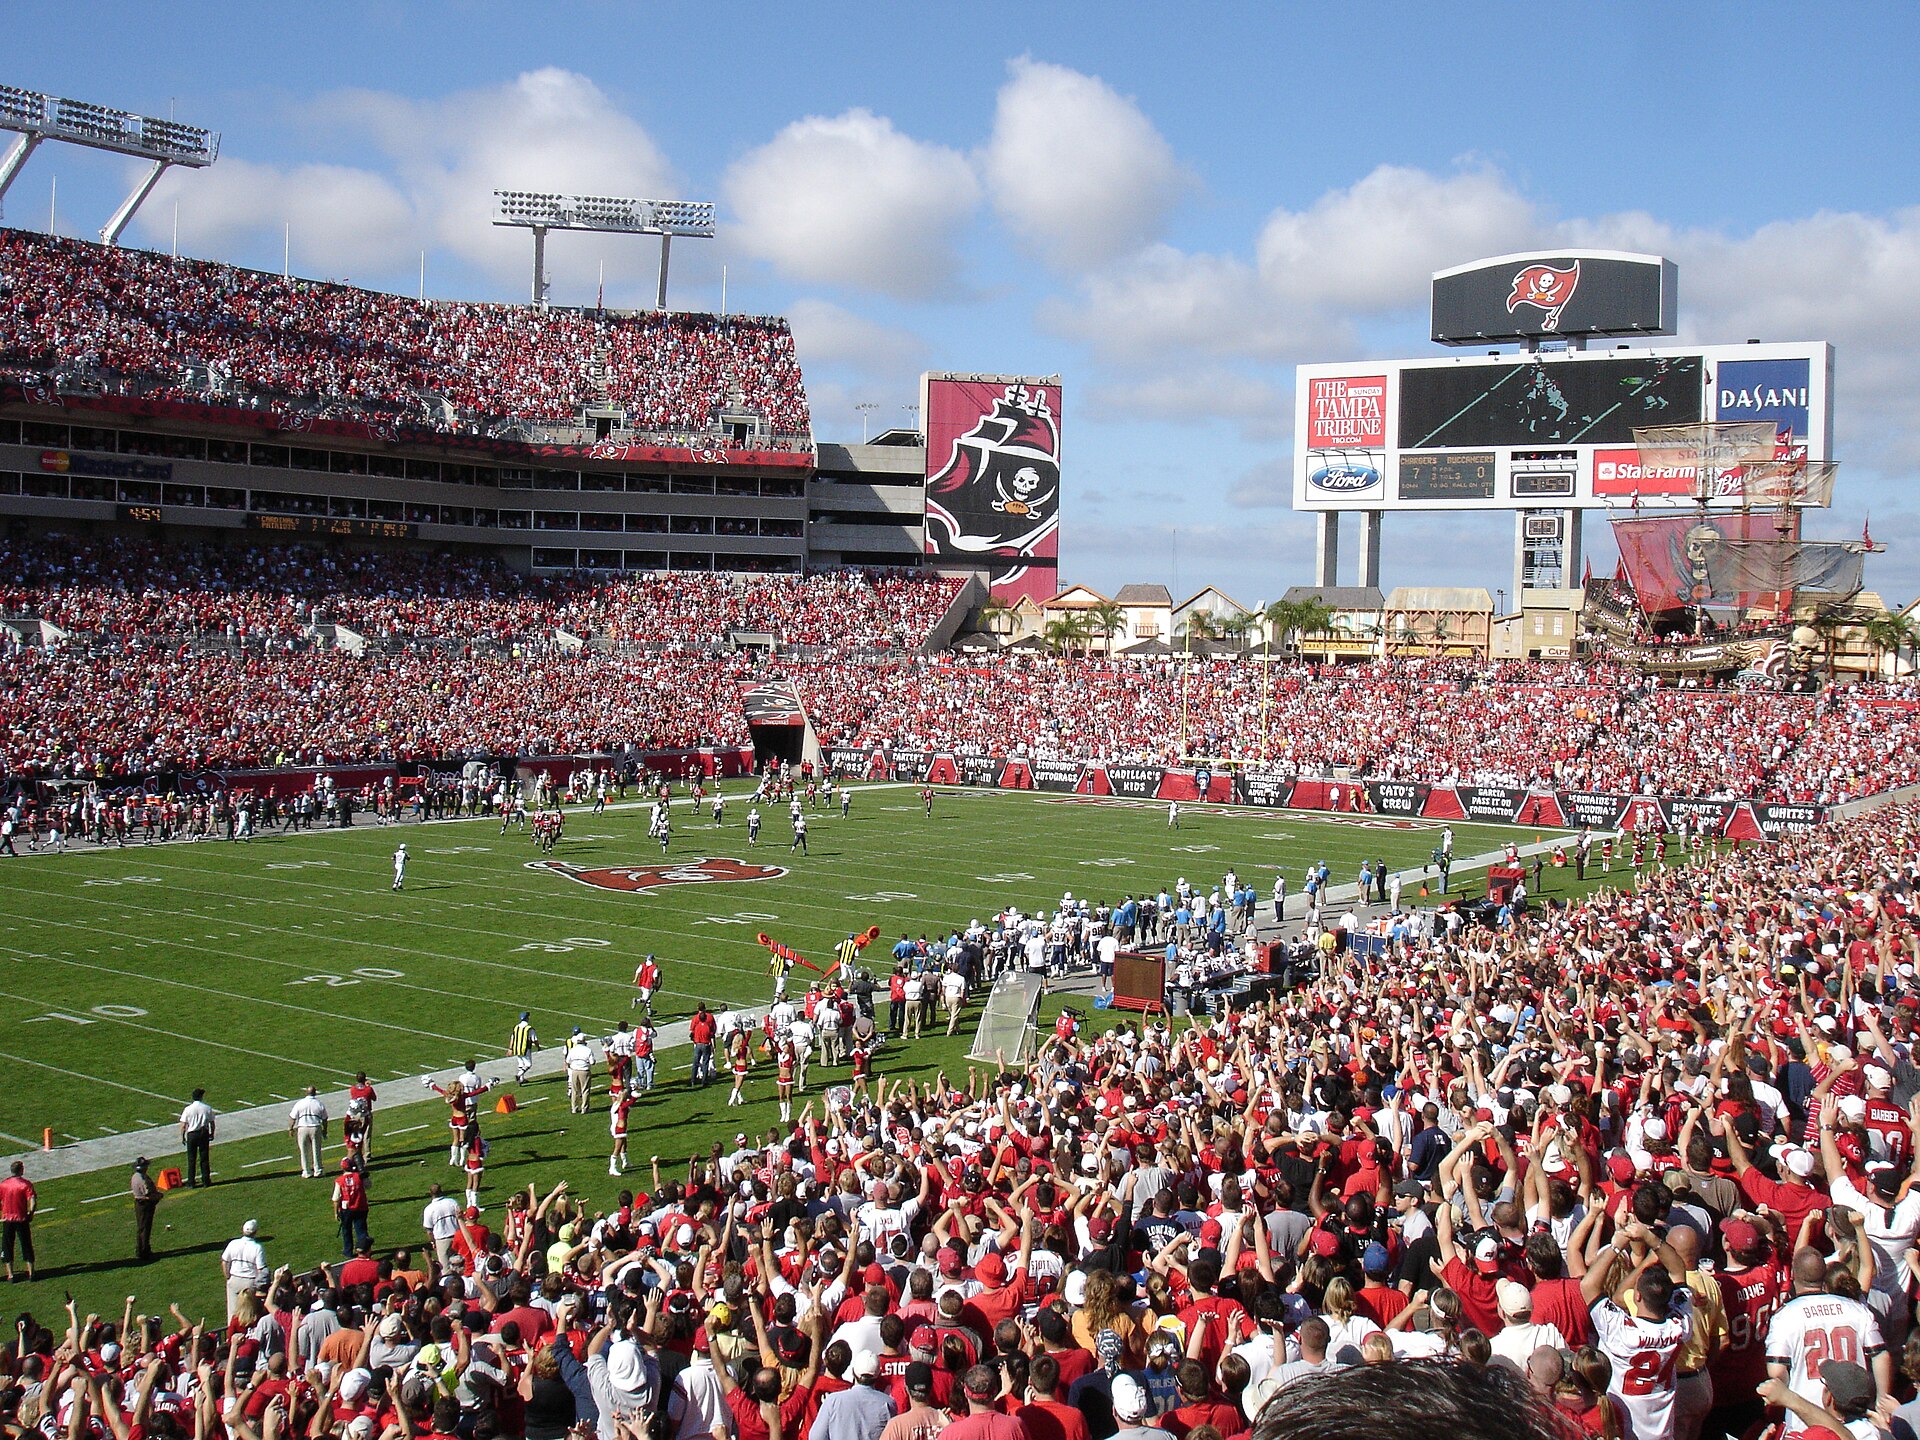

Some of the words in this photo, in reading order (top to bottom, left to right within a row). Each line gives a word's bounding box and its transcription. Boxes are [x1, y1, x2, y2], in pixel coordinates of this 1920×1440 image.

[1315, 381, 1347, 398] THE
[1353, 388, 1381, 396] SUNDAY
[1721, 383, 1806, 412] DASANI
[1315, 397, 1381, 419] TAMPA
[1314, 419, 1381, 437] TRIBUNE
[1400, 456, 1437, 465] CHARGERS
[1447, 455, 1494, 464] BUCCANEERS
[1322, 468, 1367, 488] Ford
[1477, 466, 1485, 478] 0
[129, 507, 161, 521] 4:54
[261, 516, 300, 525] CARDINALS
[1035, 771, 1079, 783] ENTOURAGE
[1109, 769, 1161, 782] CADILLAC'S
[1123, 781, 1146, 792] KIDS
[1379, 784, 1415, 797] CATO'S
[1478, 788, 1506, 798] GARCIA
[1253, 797, 1275, 806] BOAD
[1382, 798, 1412, 811] CREW
[1471, 797, 1490, 807] PASS
[1491, 798, 1501, 808] IT
[1501, 799, 1512, 809] ON
[1469, 806, 1514, 818] FOUNDATION
[1672, 803, 1722, 815] BRYANT'S
[1768, 807, 1814, 821] WHITE'S
[705, 912, 779, 924] 40
[1054, 932, 1066, 942] 97
[522, 937, 612, 953] 30
[302, 967, 406, 987] 20
[46, 1004, 149, 1025] 10
[1870, 1109, 1899, 1123] BARBER
[1184, 1220, 1203, 1230] WILLI
[1030, 1259, 1051, 1271] STOTT
[1736, 1283, 1766, 1303] ADAMS
[1802, 1303, 1844, 1319] BARBER
[1803, 1325, 1859, 1381] 20
